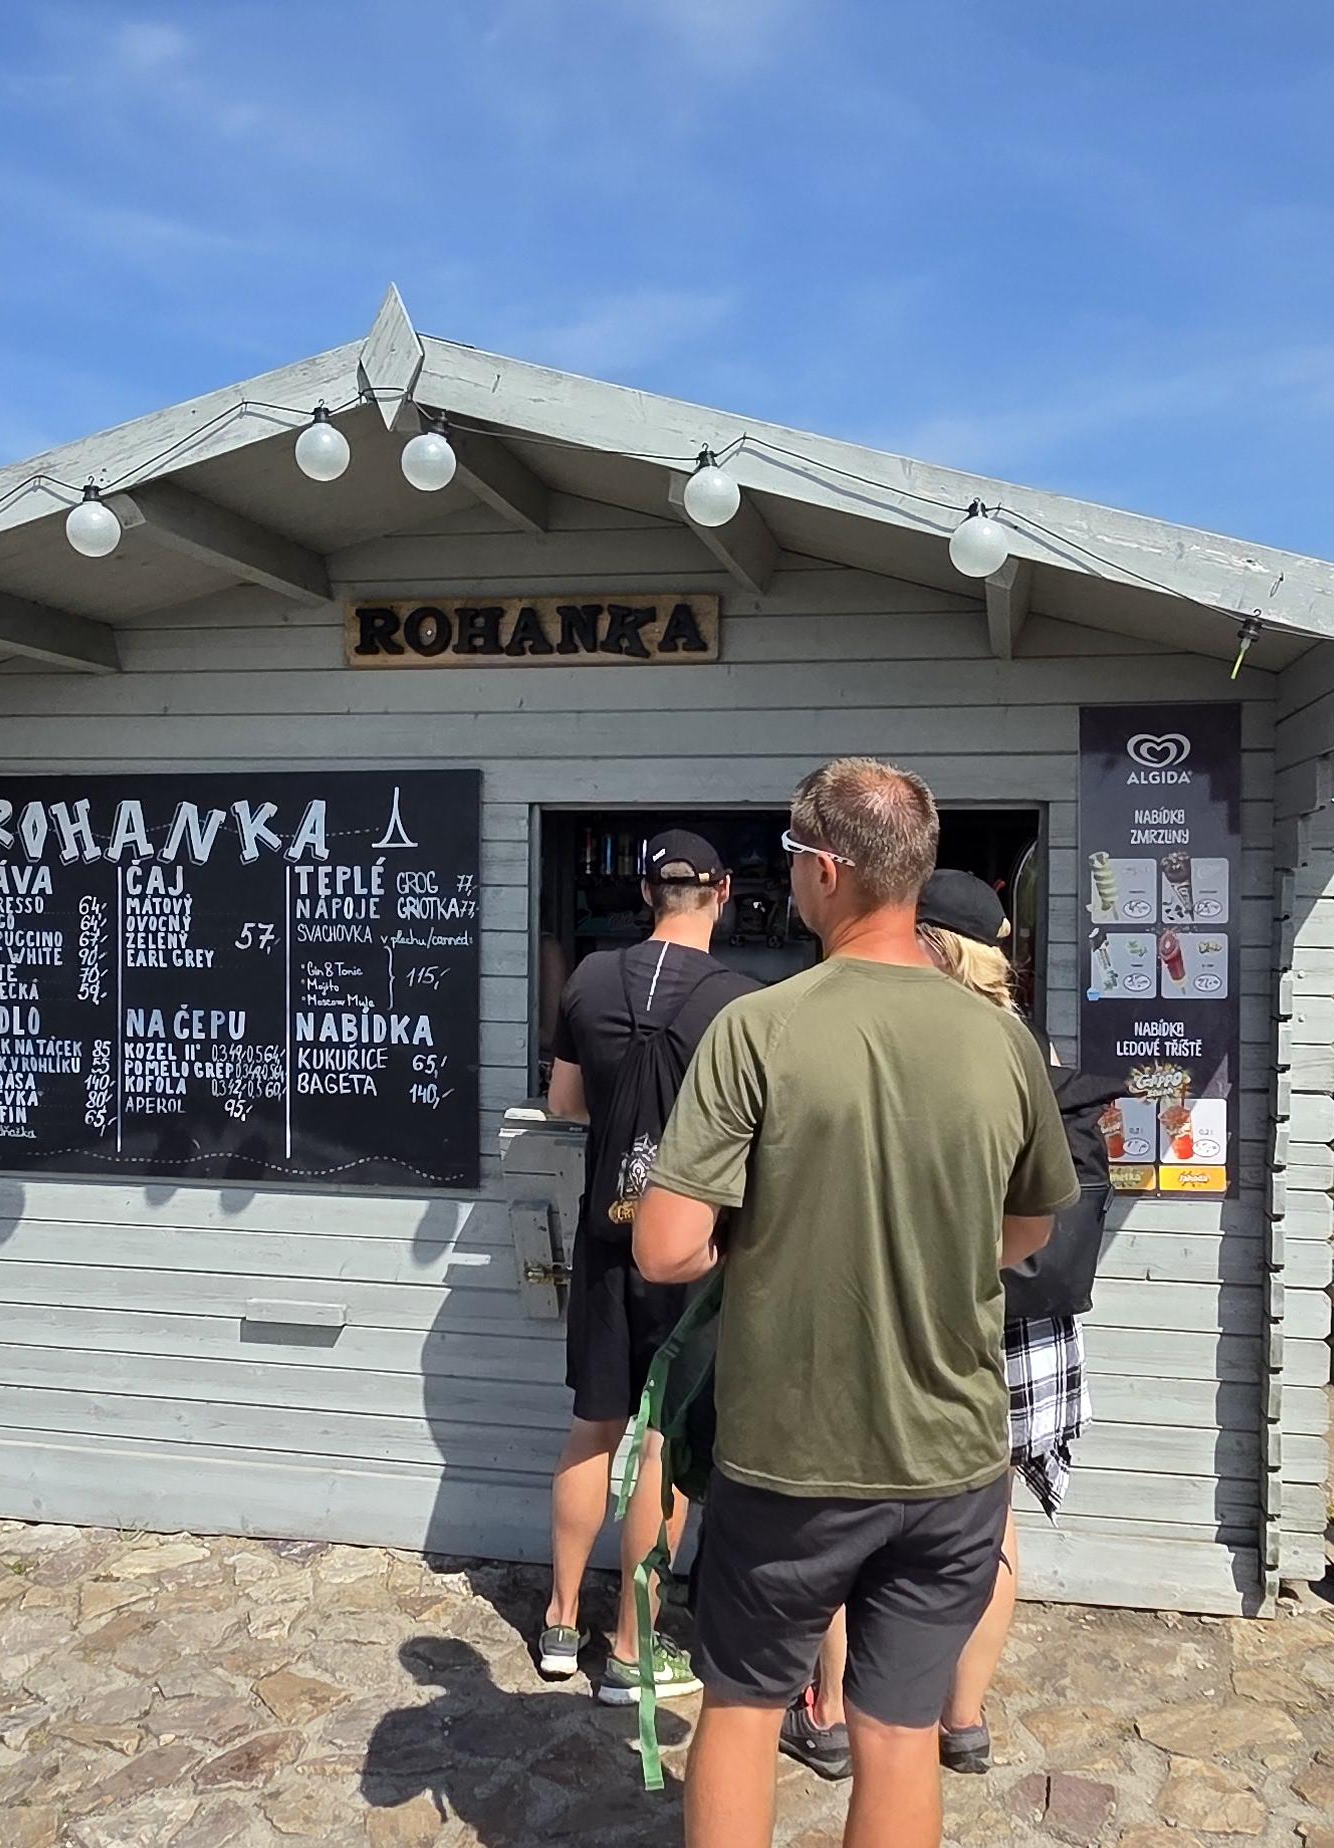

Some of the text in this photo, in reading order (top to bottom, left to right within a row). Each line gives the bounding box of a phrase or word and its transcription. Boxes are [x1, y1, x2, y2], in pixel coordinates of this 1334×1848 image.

[354, 603, 708, 658] ROHANKA
[1127, 771, 1190, 785] ALGIDA
[126, 859, 184, 896] ČAJ
[294, 856, 386, 895] TEPLÉ
[396, 870, 439, 894] GROG
[126, 893, 193, 914] MÁTOVÝ
[296, 894, 381, 919] NÁPOJE
[126, 914, 192, 931] OVOCNÝ
[125, 930, 188, 949] ZELENÝ
[297, 923, 373, 943] SVACHOVKA
[7, 946, 63, 965] WHITE
[126, 949, 214, 968] EARL GREY
[307, 961, 324, 976] Gin
[334, 962, 363, 976] Tonic
[307, 977, 340, 996] Mojito
[307, 994, 345, 1006] Moscow
[126, 1004, 246, 1040] NA ČEPU
[295, 1006, 434, 1046] NABÍDKA
[15, 1039, 34, 1055] NA
[124, 1042, 177, 1060] KOZEL
[1117, 1039, 1203, 1057] LEDOVÉ TŘÍŠTĚ
[10, 1056, 19, 1072] V
[21, 1055, 81, 1073] ROHLÍKU
[297, 1043, 389, 1071] KUKUŘICE
[124, 1059, 189, 1078] POMELO
[194, 1062, 234, 1078] GREP
[124, 1075, 187, 1094] KOFOLA
[297, 1072, 378, 1096] BAGETA
[124, 1096, 187, 1113] APEROL
